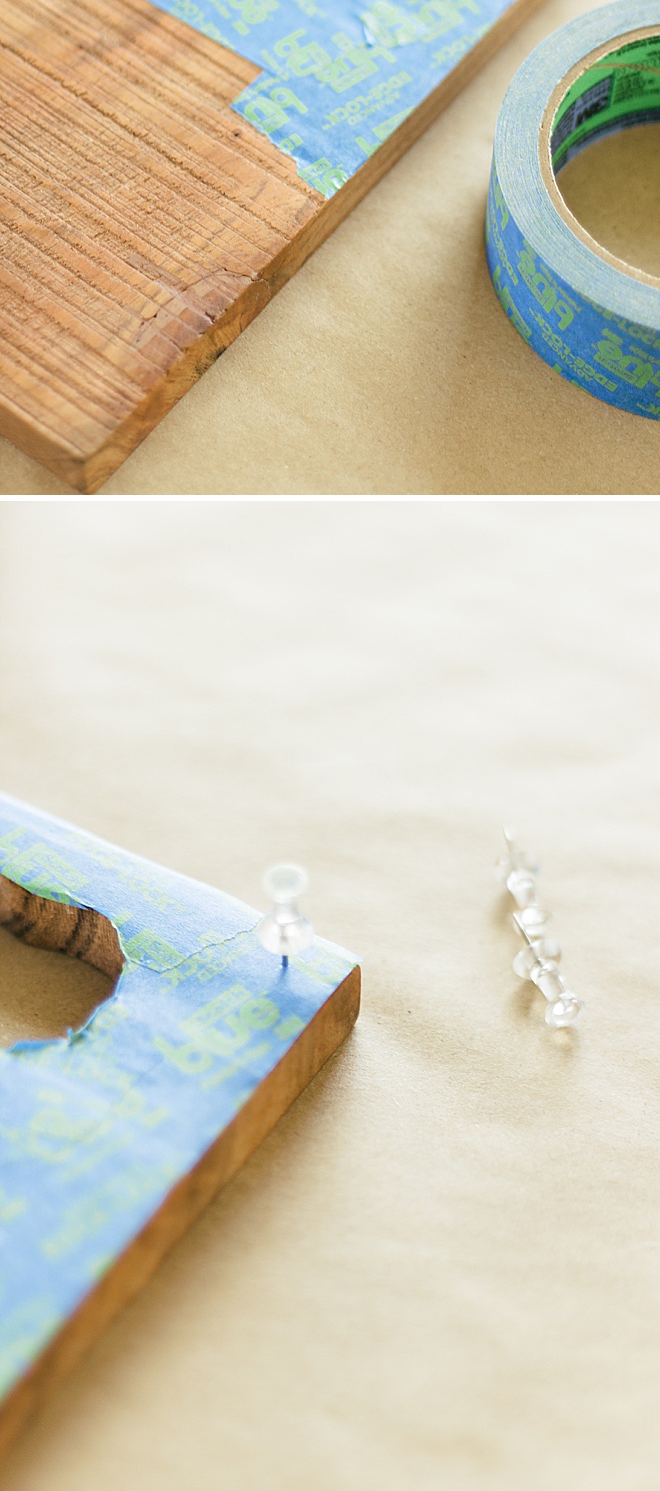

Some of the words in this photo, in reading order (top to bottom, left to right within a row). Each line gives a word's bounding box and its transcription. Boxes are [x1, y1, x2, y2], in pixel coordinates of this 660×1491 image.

[519, 250, 574, 331] blue
[541, 332, 592, 382] ADVANCED
[152, 998, 280, 1074] blue
